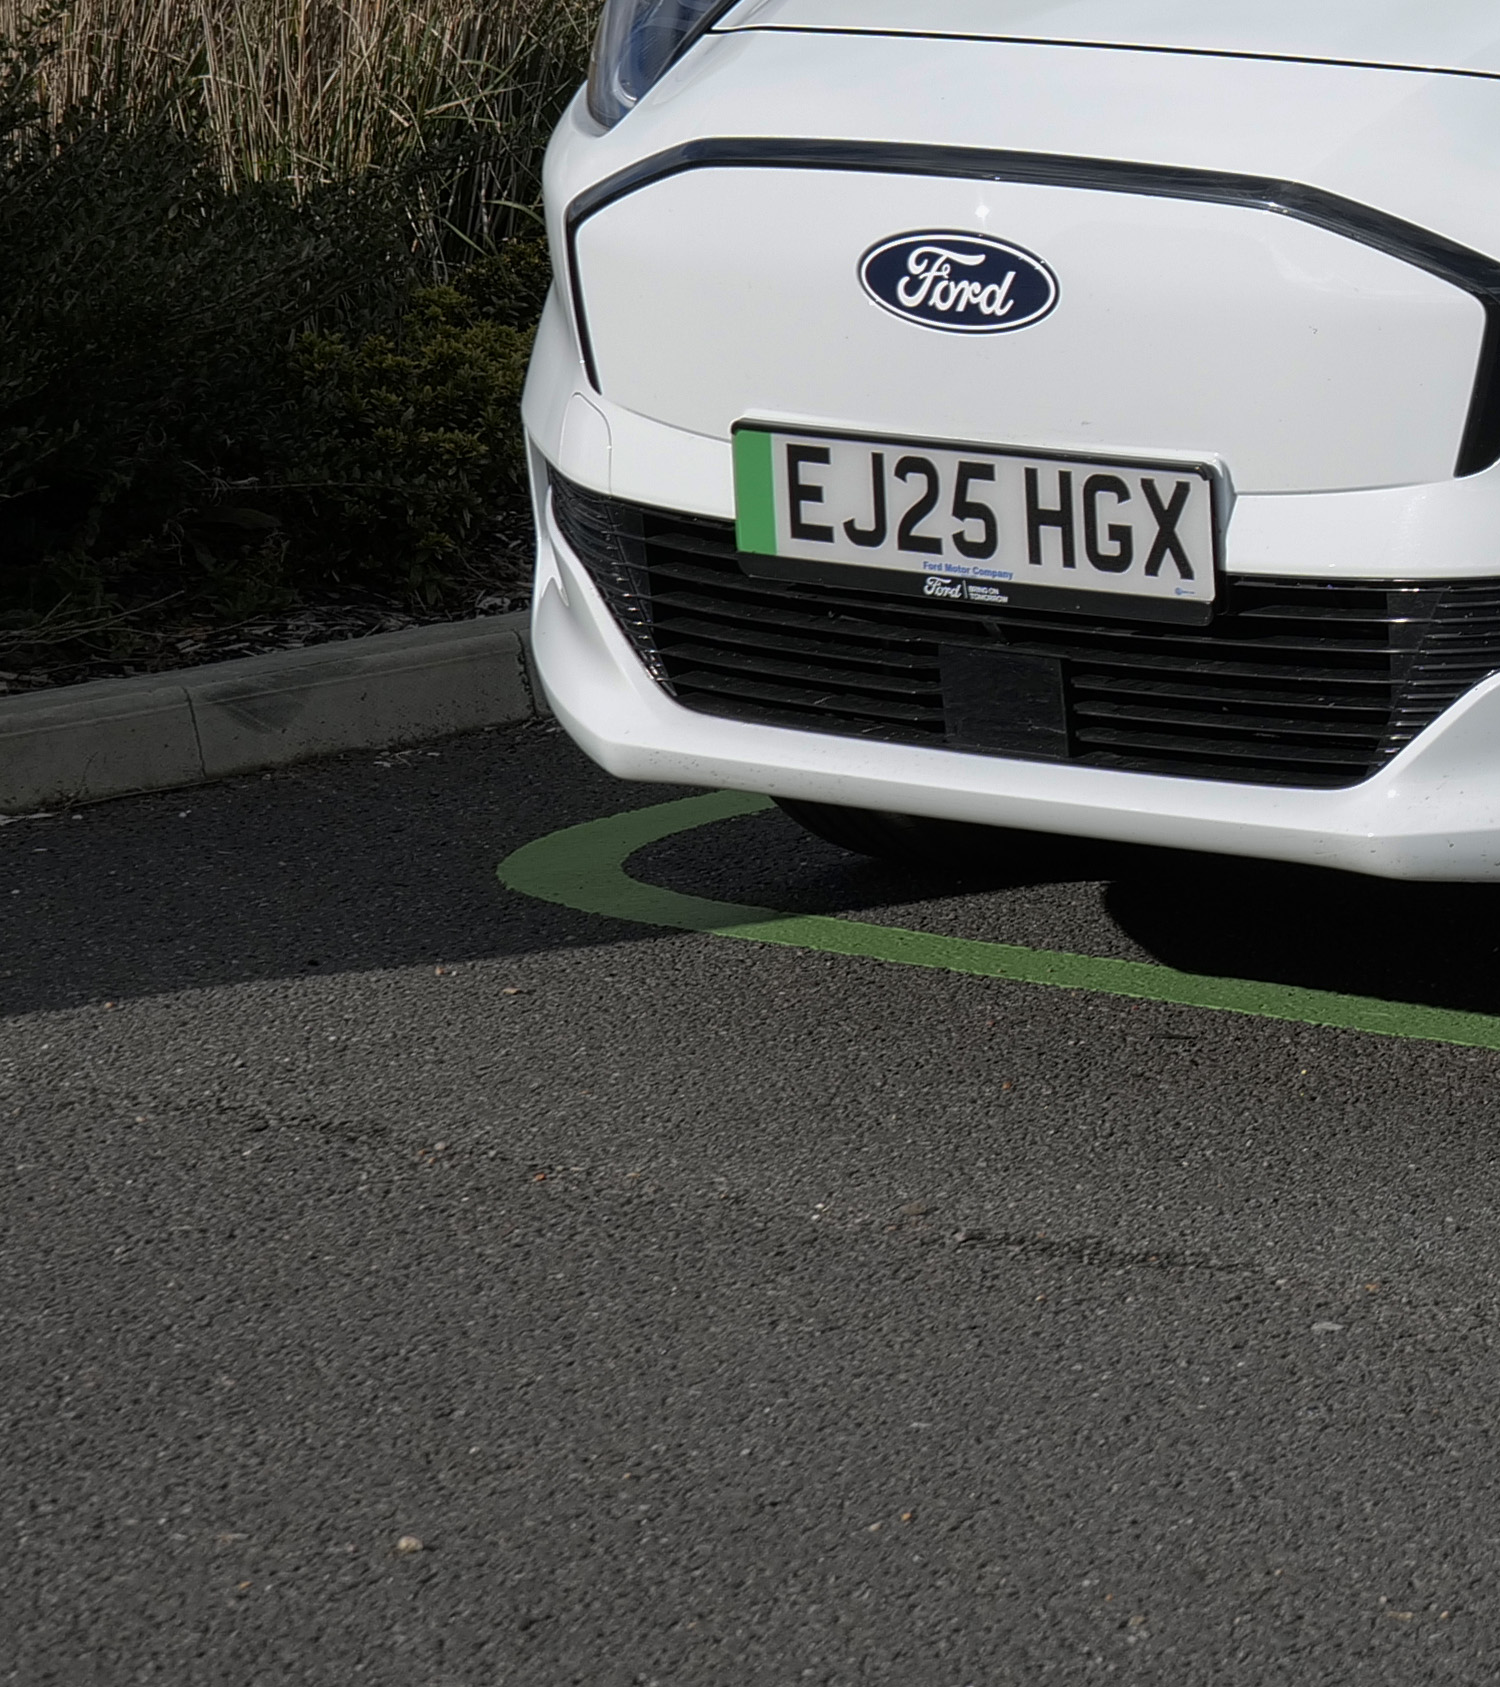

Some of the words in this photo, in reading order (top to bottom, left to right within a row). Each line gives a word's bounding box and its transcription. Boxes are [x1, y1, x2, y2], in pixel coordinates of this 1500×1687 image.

[896, 245, 1017, 317] Ford
[784, 443, 1001, 562] EJ25
[1023, 466, 1196, 581] HGX
[922, 560, 943, 572] Ford
[944, 562, 971, 576] Motor
[972, 565, 1014, 580] Company
[923, 576, 963, 599] Ford
